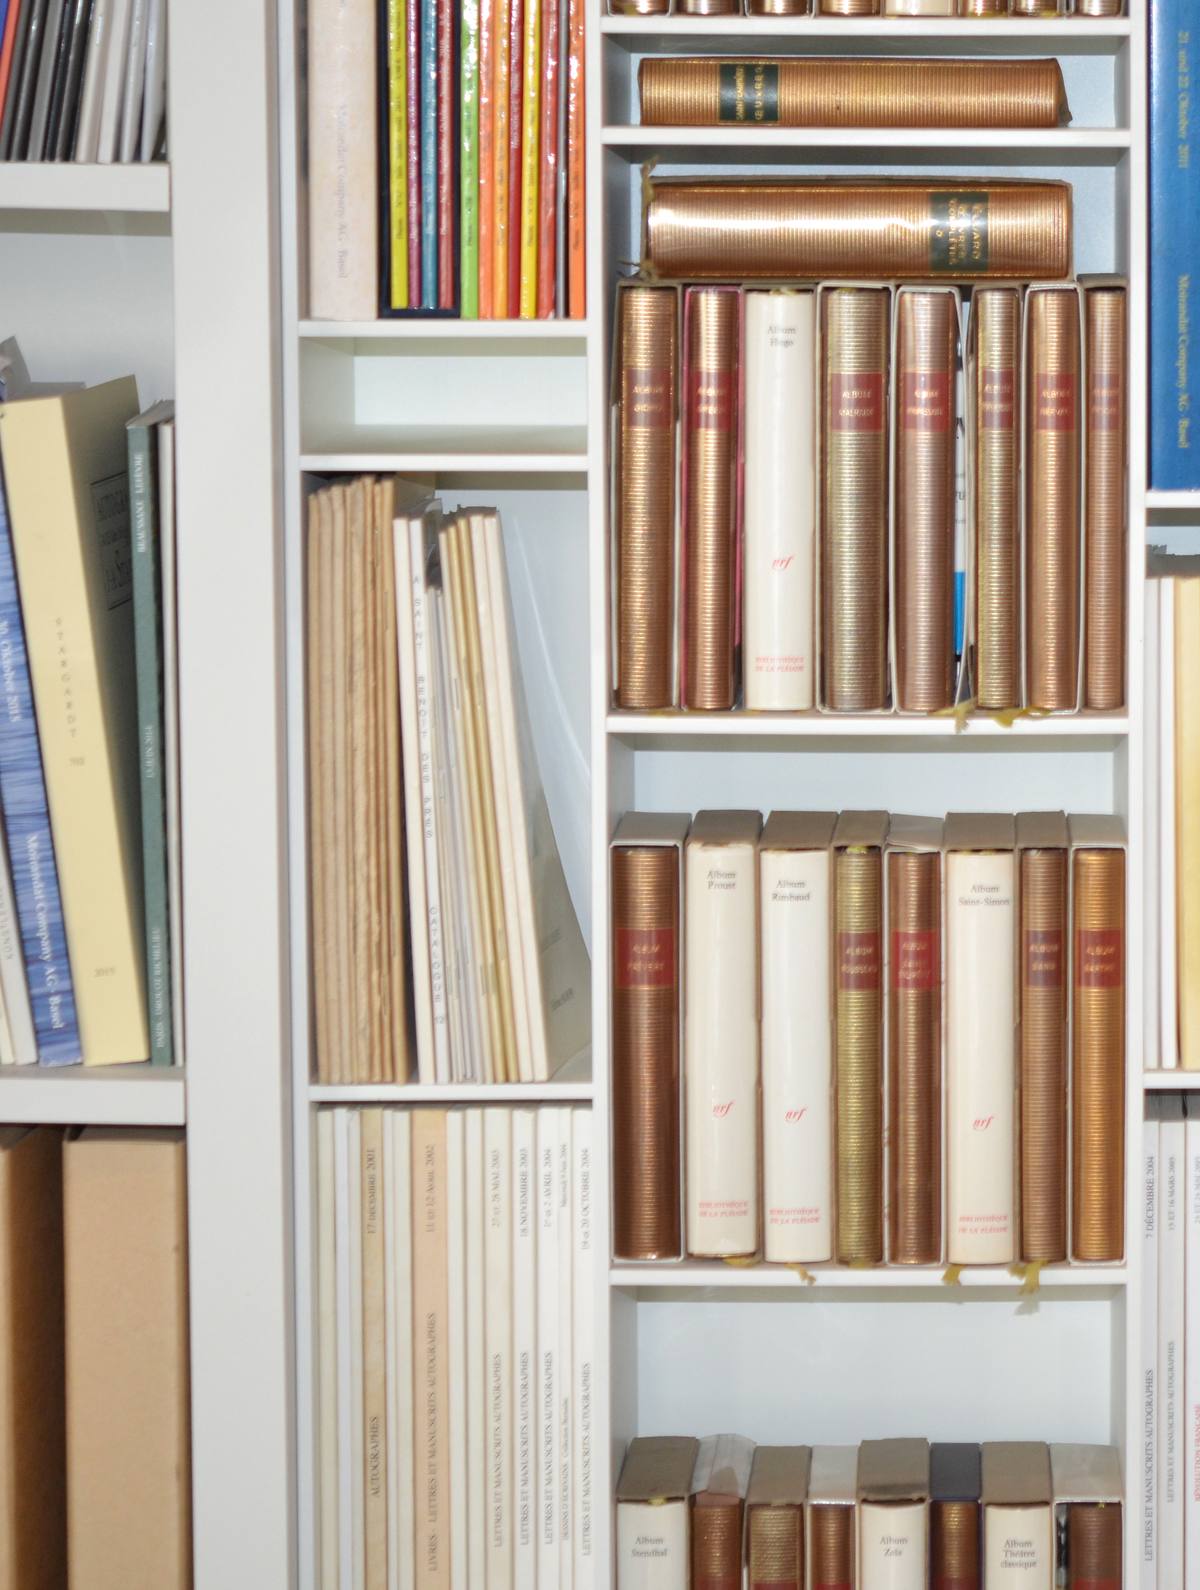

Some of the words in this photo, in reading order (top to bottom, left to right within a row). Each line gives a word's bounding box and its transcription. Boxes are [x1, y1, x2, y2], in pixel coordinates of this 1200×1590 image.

[707, 870, 736, 879] Album
[708, 881, 736, 890] Proust
[776, 880, 806, 889] Album
[971, 884, 999, 893] Album
[772, 893, 810, 901] Rimbaud
[958, 897, 1010, 906] Saint-Simon
[35, 902, 53, 962] Company
[48, 996, 64, 1030] Basel
[713, 1101, 734, 1117] nrf
[785, 1109, 806, 1122] nrf
[972, 1116, 994, 1130] nrf
[1146, 1156, 1154, 1176] 2004
[1144, 1179, 1155, 1232] DÉCEMBRE
[1144, 1368, 1154, 1439] AUTOGRAPHES
[370, 1416, 380, 1498] AUTOGRAPHES
[1144, 1442, 1154, 1503] MANUSCRITS
[1144, 1506, 1154, 1518] ET
[635, 1536, 664, 1545] Album
[880, 1537, 908, 1545] Album
[1004, 1539, 1032, 1548] Album
[1144, 1520, 1154, 1562] LETTRES
[631, 1548, 668, 1557] Stendhal
[884, 1548, 902, 1557] Zola
[1000, 1560, 1036, 1570] classique
